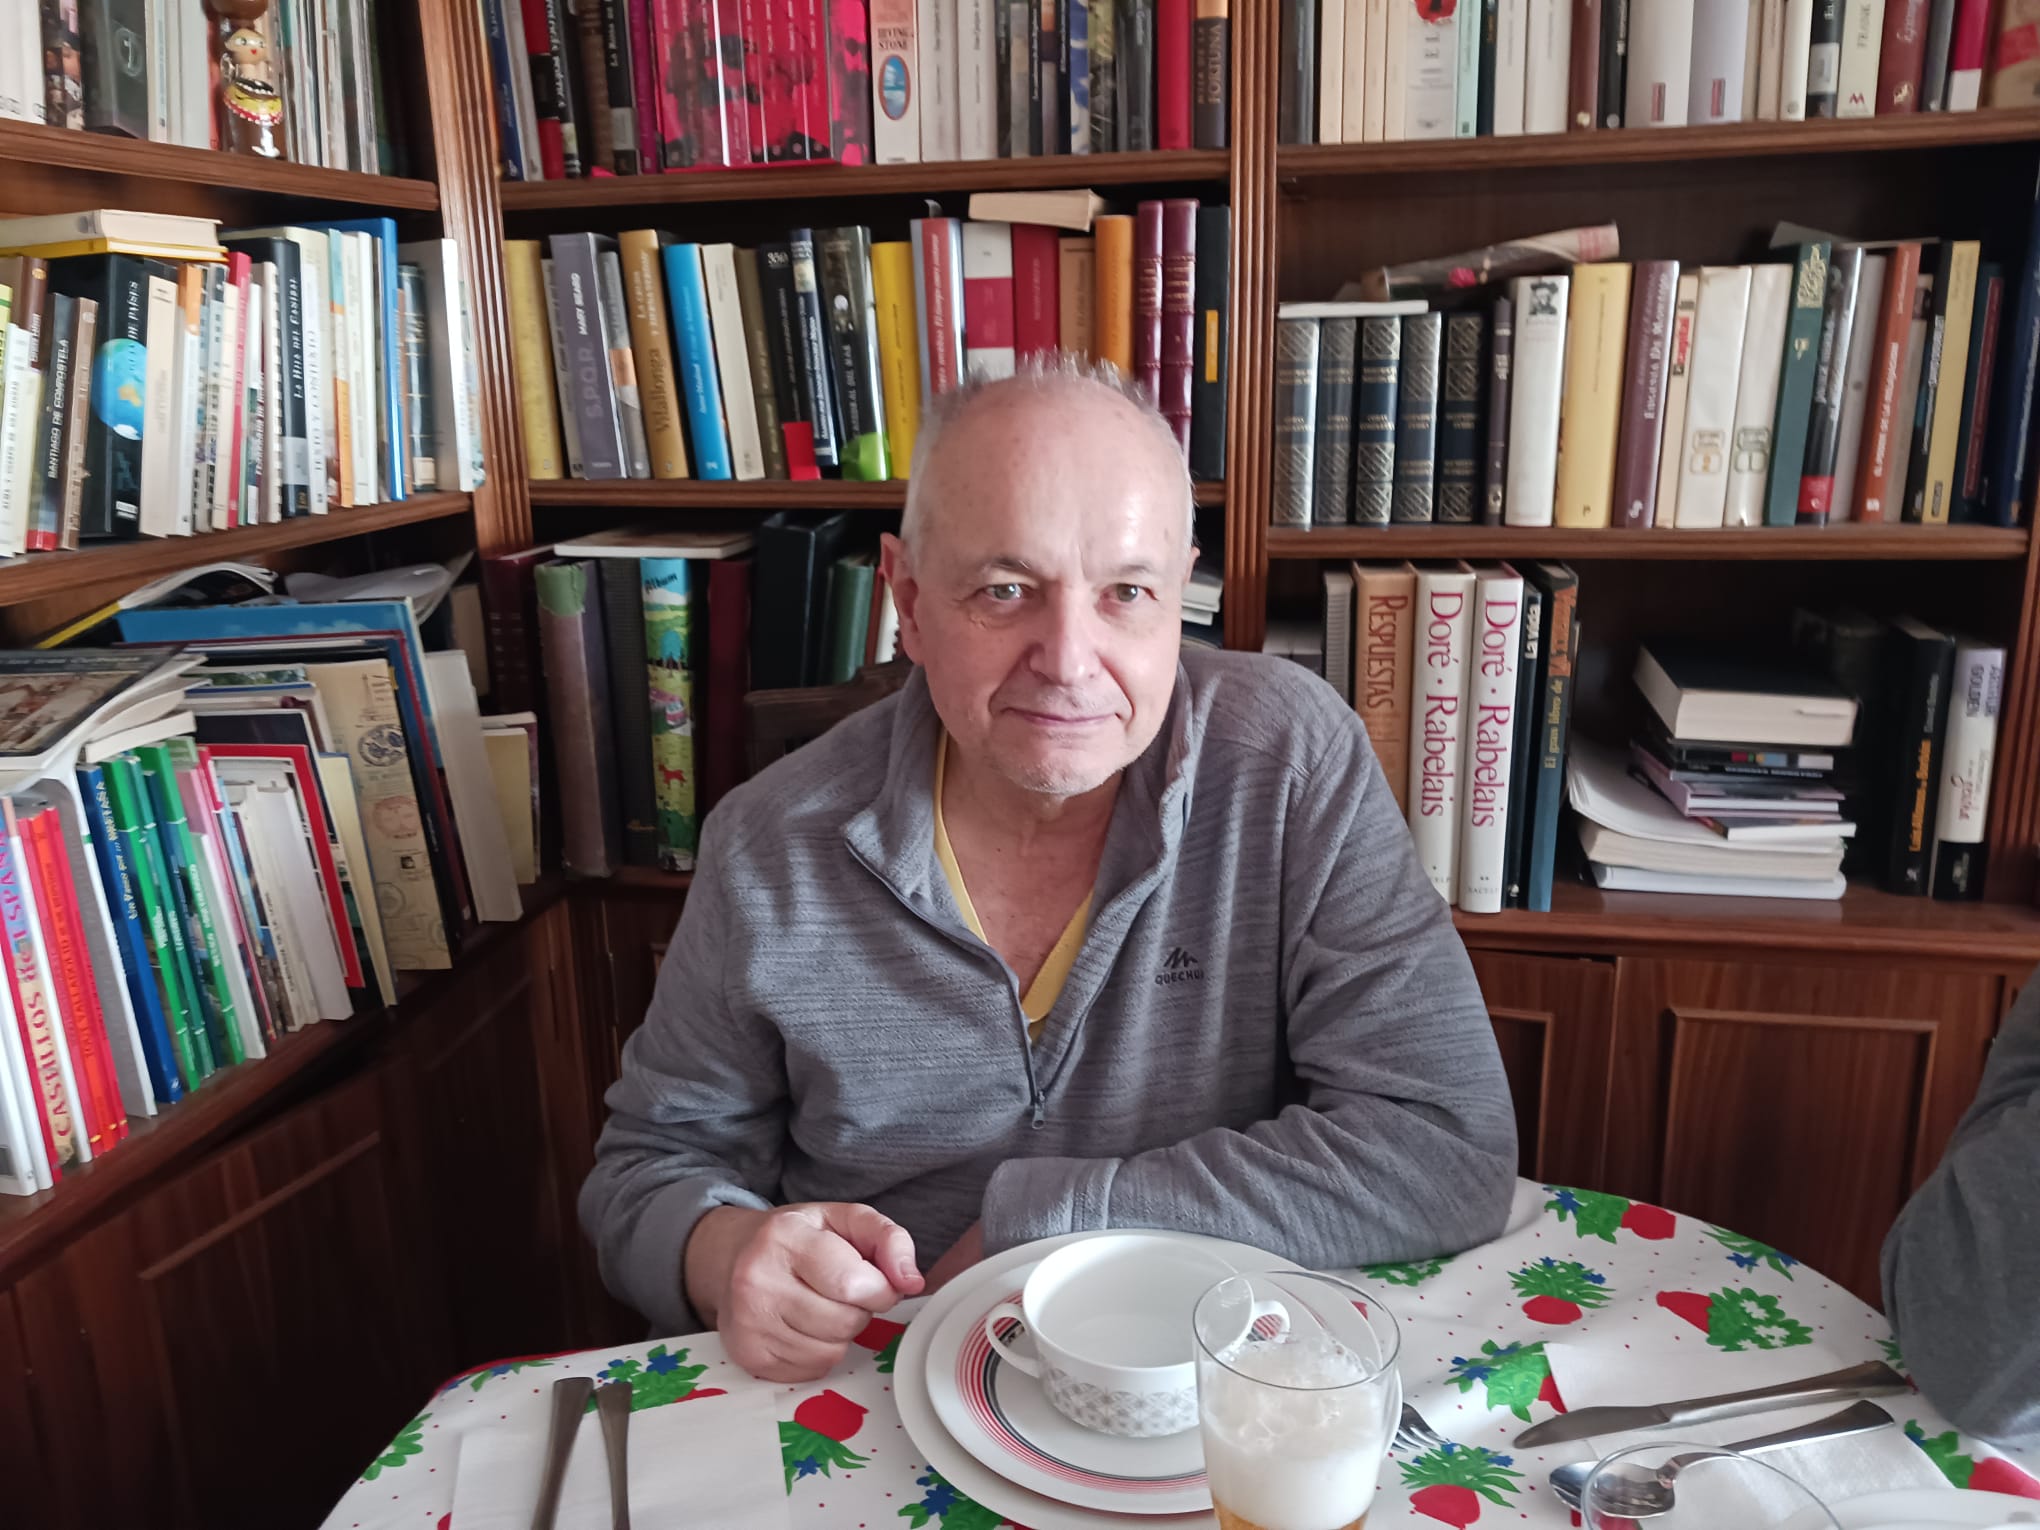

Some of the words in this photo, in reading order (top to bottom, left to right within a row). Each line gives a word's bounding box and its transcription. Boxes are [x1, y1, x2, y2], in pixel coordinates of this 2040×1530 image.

[55, 339, 69, 408] COMPOSTELA
[53, 409, 64, 425] DE
[48, 428, 62, 478] SANTIAGO
[1427, 591, 1464, 669] Doré
[1481, 600, 1518, 678] Doré
[1527, 602, 1541, 640] vida
[1525, 639, 1538, 660] La
[1551, 679, 1563, 694] de
[1549, 697, 1562, 724] libro
[1421, 694, 1459, 817] Rabelais
[1549, 727, 1561, 753] gran
[1472, 703, 1511, 828] Rabelais
[1544, 757, 1557, 769] El
[28, 991, 71, 1137] CASTILLOS
